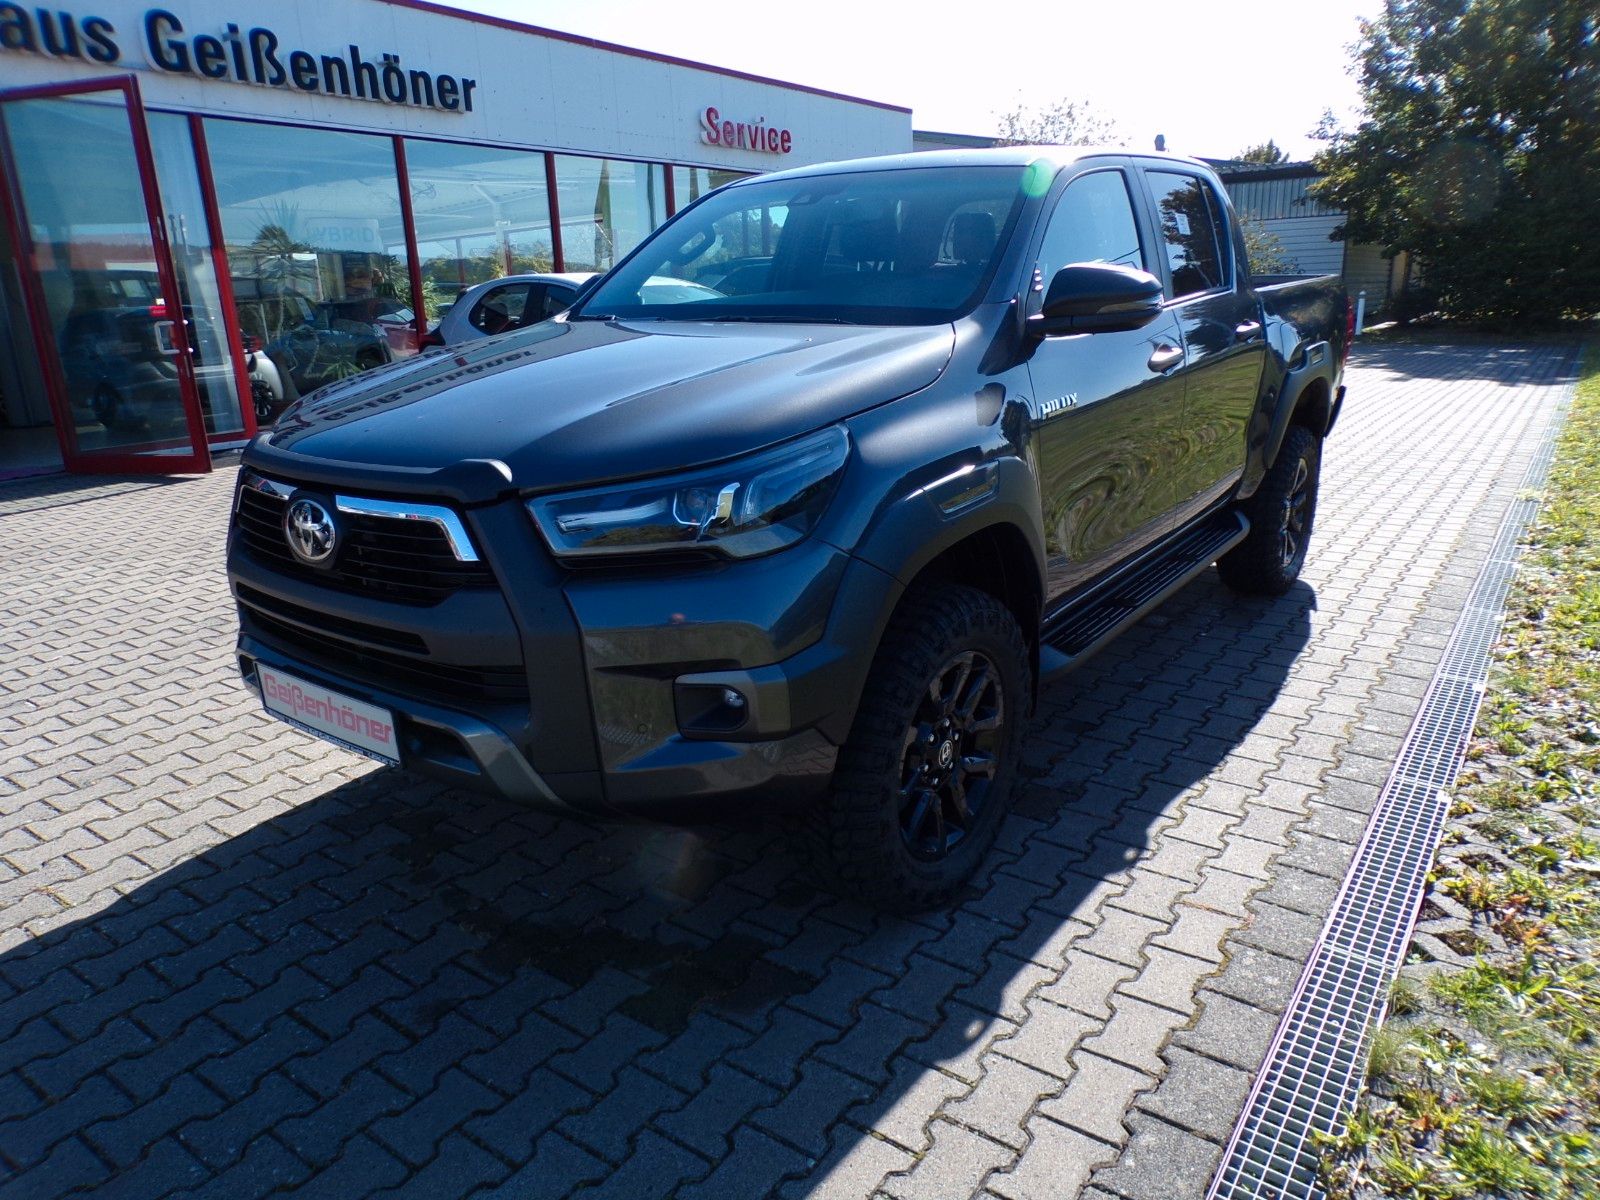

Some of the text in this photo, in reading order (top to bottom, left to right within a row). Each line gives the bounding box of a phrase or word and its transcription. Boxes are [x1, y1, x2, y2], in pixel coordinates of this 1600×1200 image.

[0, 2, 476, 113] aus Geißenhöner
[703, 107, 792, 154] Service
[263, 673, 392, 744] Geißenhöner
